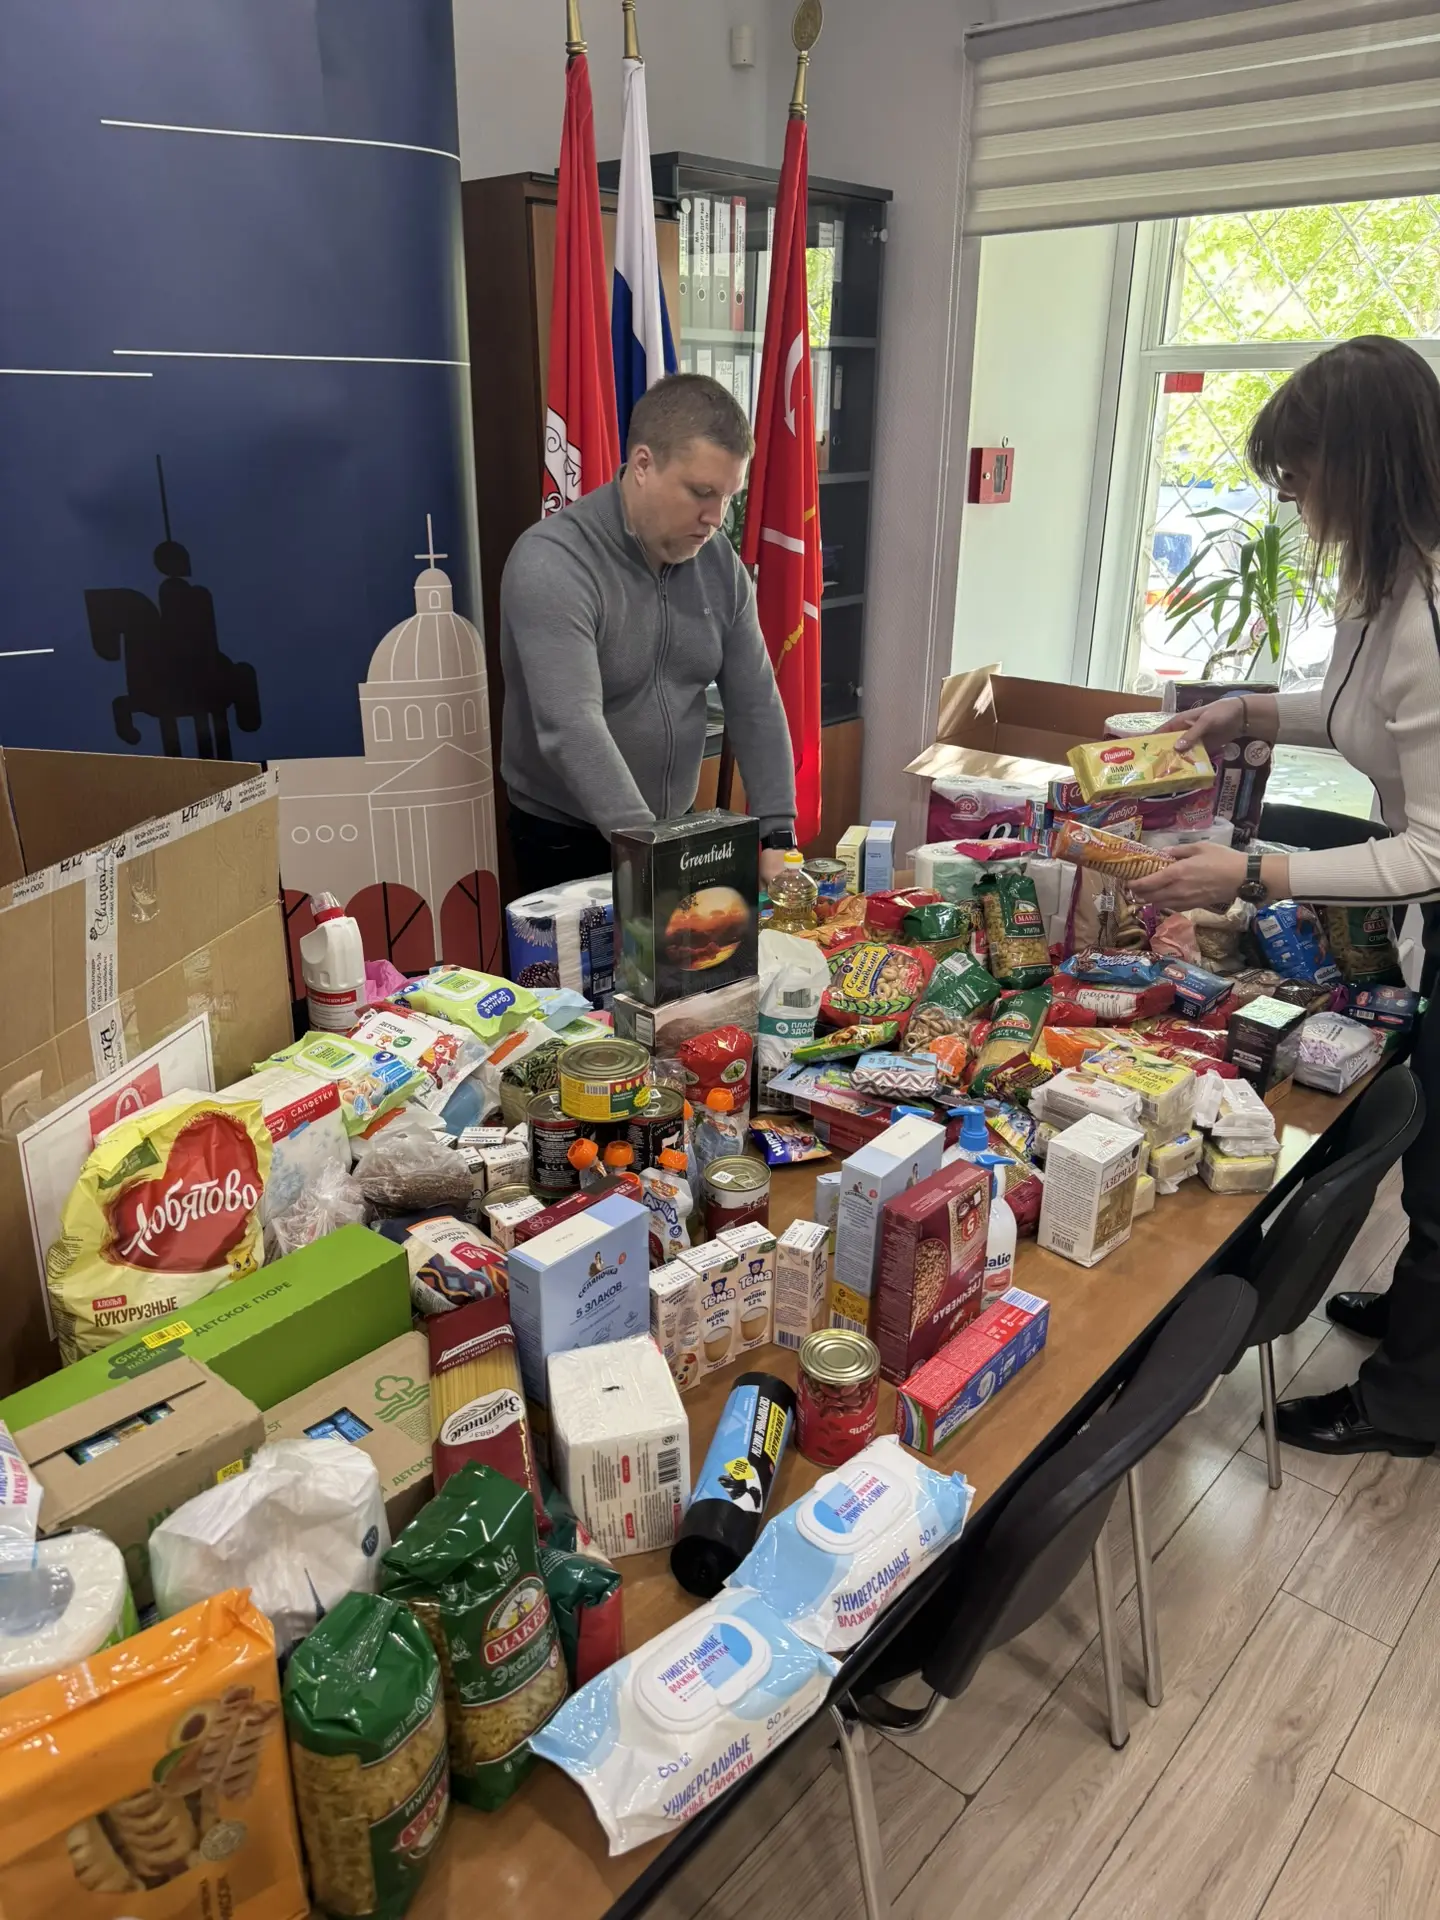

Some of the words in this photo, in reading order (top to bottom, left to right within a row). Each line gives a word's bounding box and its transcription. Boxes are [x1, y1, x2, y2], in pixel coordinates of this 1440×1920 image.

[1103, 749, 1132, 761] Яшкино
[1110, 765, 1134, 773] ВАФЛИ
[1107, 805, 1138, 821] Colgate
[680, 841, 733, 870] Greenfield
[379, 1021, 405, 1034] ДЕТСКИЕ
[791, 1028, 815, 1036] ЗДОР
[291, 1090, 334, 1117] САЛФЕТКИ
[1104, 1161, 1137, 1191] АЗЕРЧАЙ
[122, 1169, 257, 1257] Любятово
[94, 1296, 178, 1328] КУКУРУЗНЫЕ
[193, 1303, 252, 1337] ДЕТСКОЕ
[252, 1281, 292, 1304] ПЮРЕ
[576, 1308, 583, 1318] 5
[585, 1281, 623, 1313] ЗЛАКОВ
[933, 1278, 982, 1324] ГРЕЧНЕВАЯ
[706, 1310, 730, 1323] МОЛОКО
[115, 1346, 147, 1365] Gipo
[450, 1395, 520, 1442] Знатные
[473, 1427, 495, 1437] 1883
[849, 1416, 877, 1435] СОЛЬ
[771, 1410, 786, 1457] LIBERHAUS
[392, 1457, 433, 1486] ДЕТСКО
[735, 1460, 748, 1474] 160
[842, 1481, 891, 1524] УНИВЕРСАЛЬНЫЕ
[919, 1530, 931, 1547] 80
[833, 1548, 911, 1614] УНИВЕРСАЛЬНЫЕ
[837, 1598, 879, 1628] ВЛАЖНЫЕ
[657, 1634, 721, 1686] УНИВЕРСАЛЬНЫЕ
[668, 1668, 700, 1694] ВЛАЖНЫЕ
[697, 1643, 730, 1671] САЛФЕТКИ
[766, 1712, 781, 1730] 80
[662, 1733, 752, 1819] УНИВЕРСАЛЬНЫЕ
[708, 1753, 754, 1798] САЛФЕТКИ
